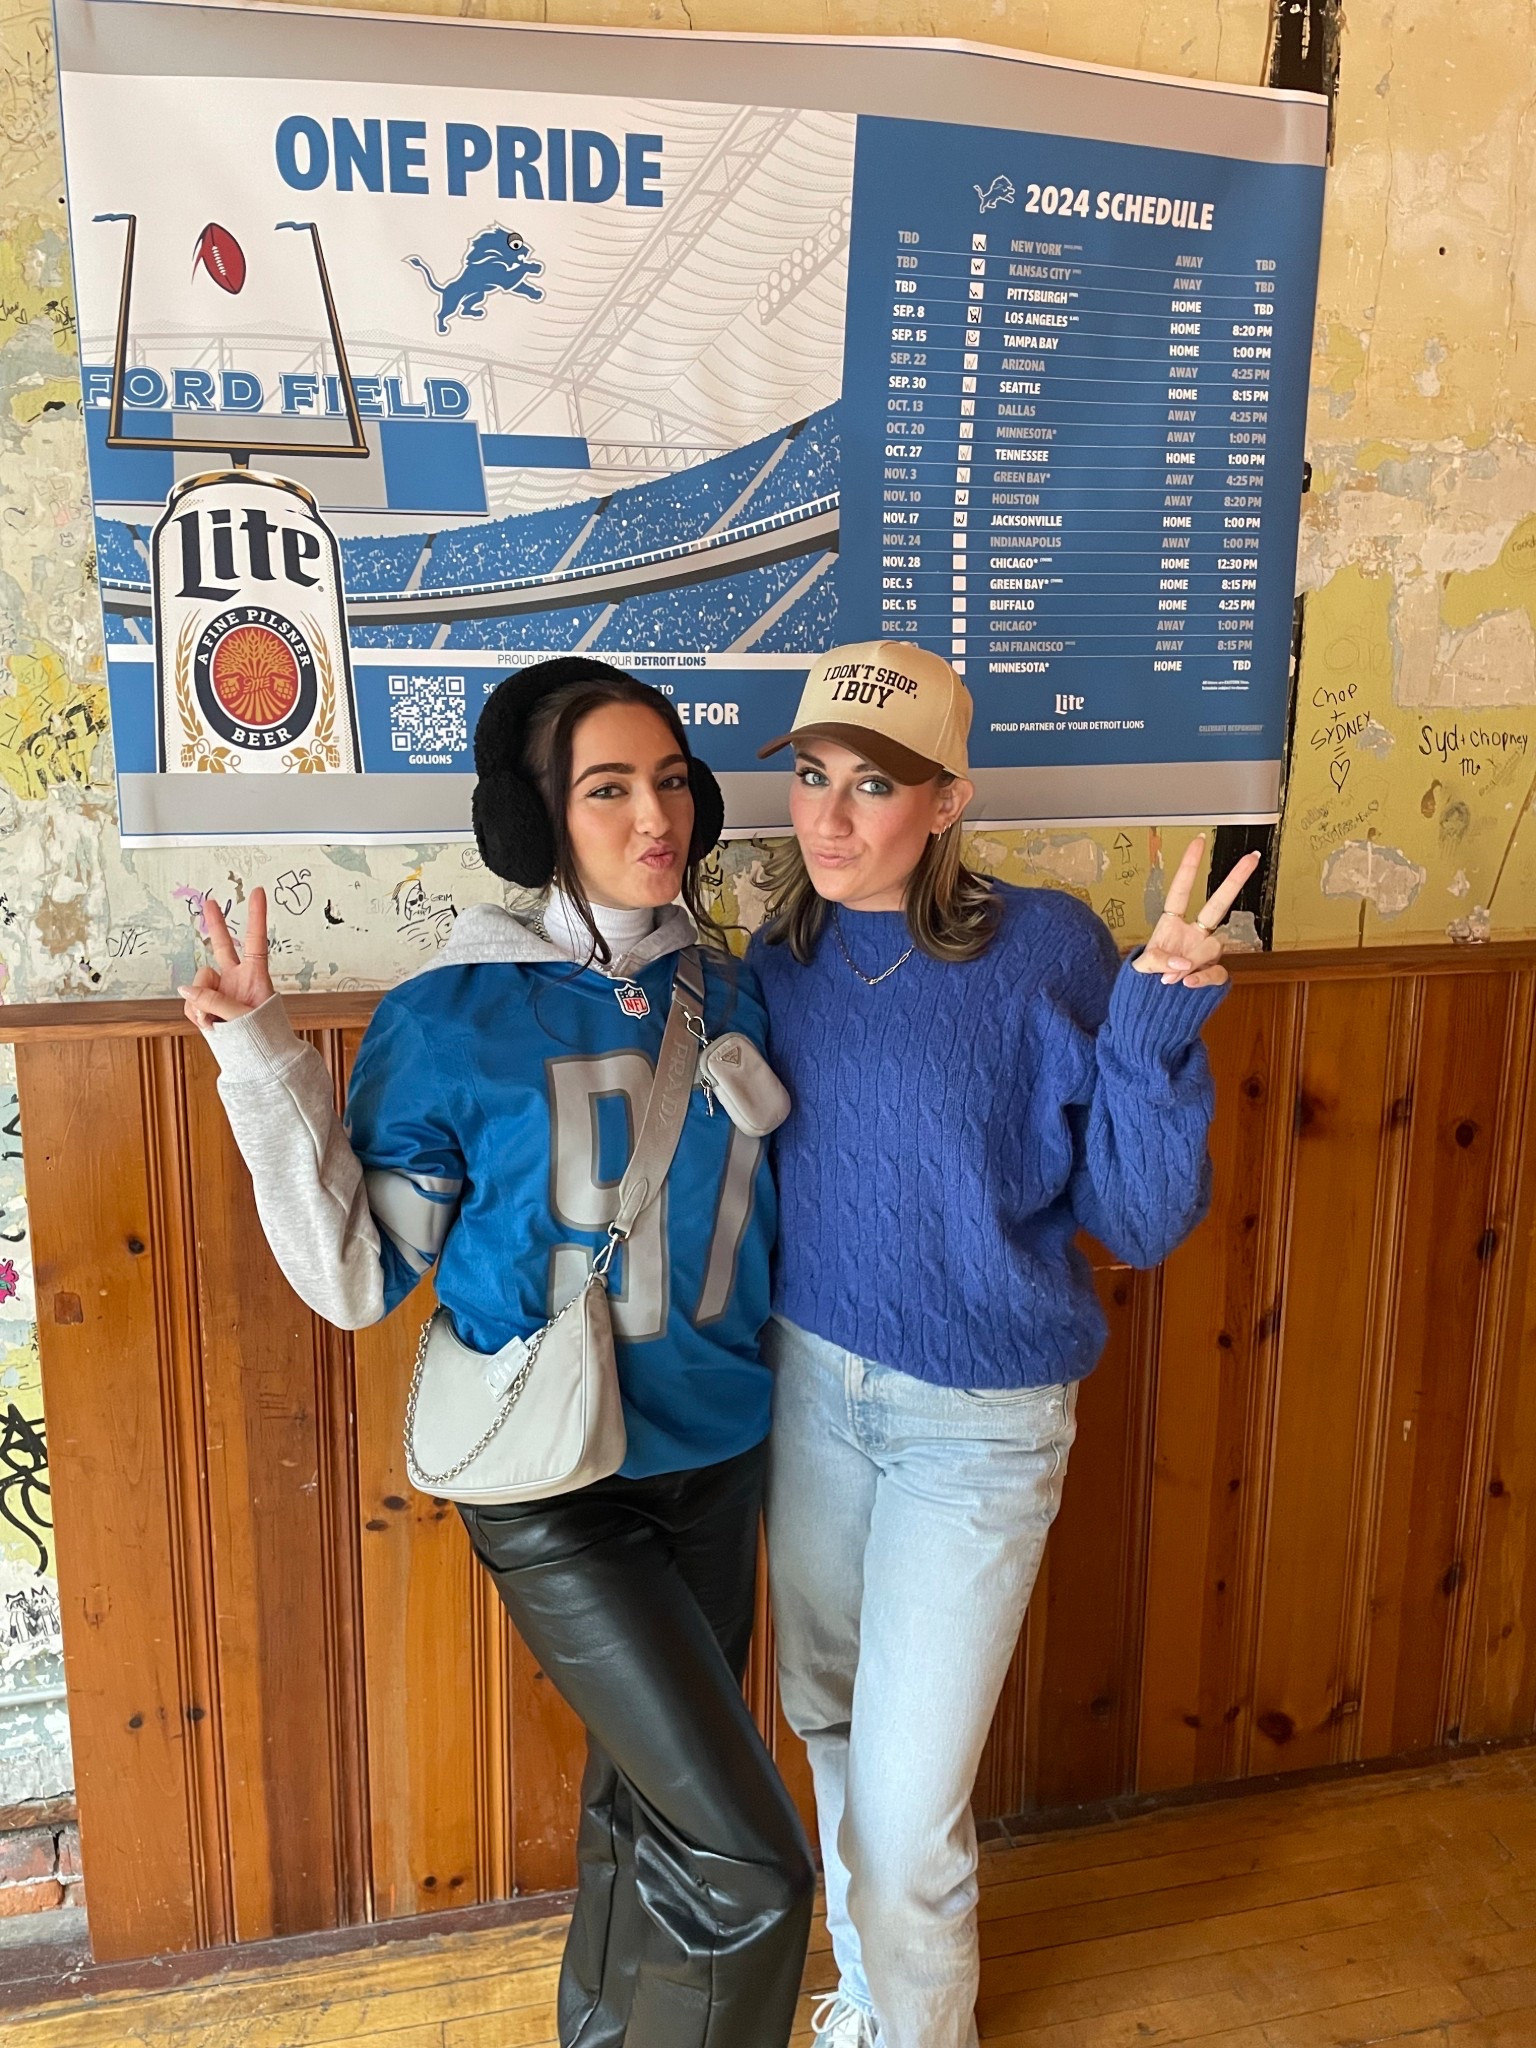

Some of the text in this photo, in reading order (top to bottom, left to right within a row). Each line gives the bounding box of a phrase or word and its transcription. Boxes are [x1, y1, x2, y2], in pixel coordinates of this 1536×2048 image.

[275, 114, 664, 208] ONE PRIDE
[1025, 183, 1215, 232] 2024 SCHEDULE
[898, 231, 919, 244] TBD
[1011, 239, 1034, 253] NEW
[1036, 242, 1062, 256] YORK
[1176, 256, 1203, 268] AWAY
[1256, 259, 1276, 271] TBD
[897, 256, 918, 268] TBD
[1009, 264, 1048, 279] KANSAS
[1050, 268, 1071, 281] CITY
[1174, 278, 1202, 290] AWAY
[1255, 281, 1274, 293] TBD
[895, 280, 916, 293] TBD
[1007, 288, 1068, 304] PITTSBURGH
[1172, 301, 1202, 313] HOME
[1254, 304, 1274, 315] TBD
[893, 304, 915, 317] SEP.
[917, 305, 925, 318] 8
[1005, 312, 1024, 324] LOS
[1025, 313, 1068, 327] ANGELES
[1170, 323, 1200, 335] HOME
[1232, 325, 1255, 336] 8:20
[1256, 326, 1272, 337] PM
[892, 329, 1271, 359] SEP. 15 TAMPA BAY HOME 1:00 PM
[890, 352, 1270, 380] SEP. 22 ARIZONA AWAY 4:25 PM
[83, 366, 471, 419] FORD FIELD
[889, 376, 1268, 402] SEP. 30 SEATTLE HOME 8:15 PM
[888, 399, 1267, 423] OCT. 13 DALLAS AWAY 4:25 PM
[887, 422, 1266, 444] OCT. 20 AWAY 1:00 PM
[885, 445, 1265, 465] OCT. 27 TENNESSEE HOME 1:00 PM
[884, 468, 908, 480] NOV.
[910, 469, 916, 480] 3
[994, 471, 1025, 483] GREEN
[1166, 474, 1194, 485] AWAY
[1226, 475, 1248, 486] 4:25
[1249, 476, 1263, 486] PM
[884, 490, 1262, 507] NOV. 10 HOUSTON AWAY 8:20 PM
[883, 512, 1260, 528] NOV. 17 JACKSONVILLE HOME 1:00 PM
[883, 534, 1259, 549] NOV. 24 INDIANAPOLIS AWAY 1:00 PM
[172, 507, 321, 603] Lite
[883, 556, 1257, 570] NOV. 28 HOME 12:30 PM
[883, 578, 904, 589] DEC.
[906, 578, 912, 589] 5
[990, 579, 1022, 590] GREEN
[1160, 579, 1188, 590] HOME
[1222, 580, 1241, 590] 8:15
[1242, 580, 1256, 590] PM
[883, 599, 1255, 611] DEC. 15 BUFFALO HOME 4:25 PM
[882, 620, 1253, 632] DEC. 22 AWAY 1:00 PM
[197, 608, 311, 667] A FINE PILSNER
[990, 641, 1011, 652] SAN
[1011, 641, 1063, 652] FRANCISCO
[1156, 641, 1184, 651] AWAY
[1218, 640, 1236, 651] 8:15
[1237, 640, 1252, 651] PM
[498, 654, 535, 666] PROUD
[605, 656, 632, 666] YOUR
[634, 656, 676, 667] DETROIT
[677, 656, 707, 667] LIONS
[1154, 661, 1182, 672] HOME
[1233, 660, 1251, 671] TBD
[661, 684, 674, 695] TO
[823, 663, 918, 699] I DON'T SHOP,
[832, 680, 895, 708] I BUY
[1054, 693, 1085, 715] Lite
[694, 702, 740, 726] FOR
[231, 726, 293, 747] BEER
[990, 720, 1145, 732] PROUD PARTNER OF YOUR DETROIT LIONS
[1310, 711, 1371, 751] SYDNEY
[1418, 723, 1529, 763] Syd chopney
[408, 754, 453, 765] GOLIONS
[623, 997, 648, 1013] NFL
